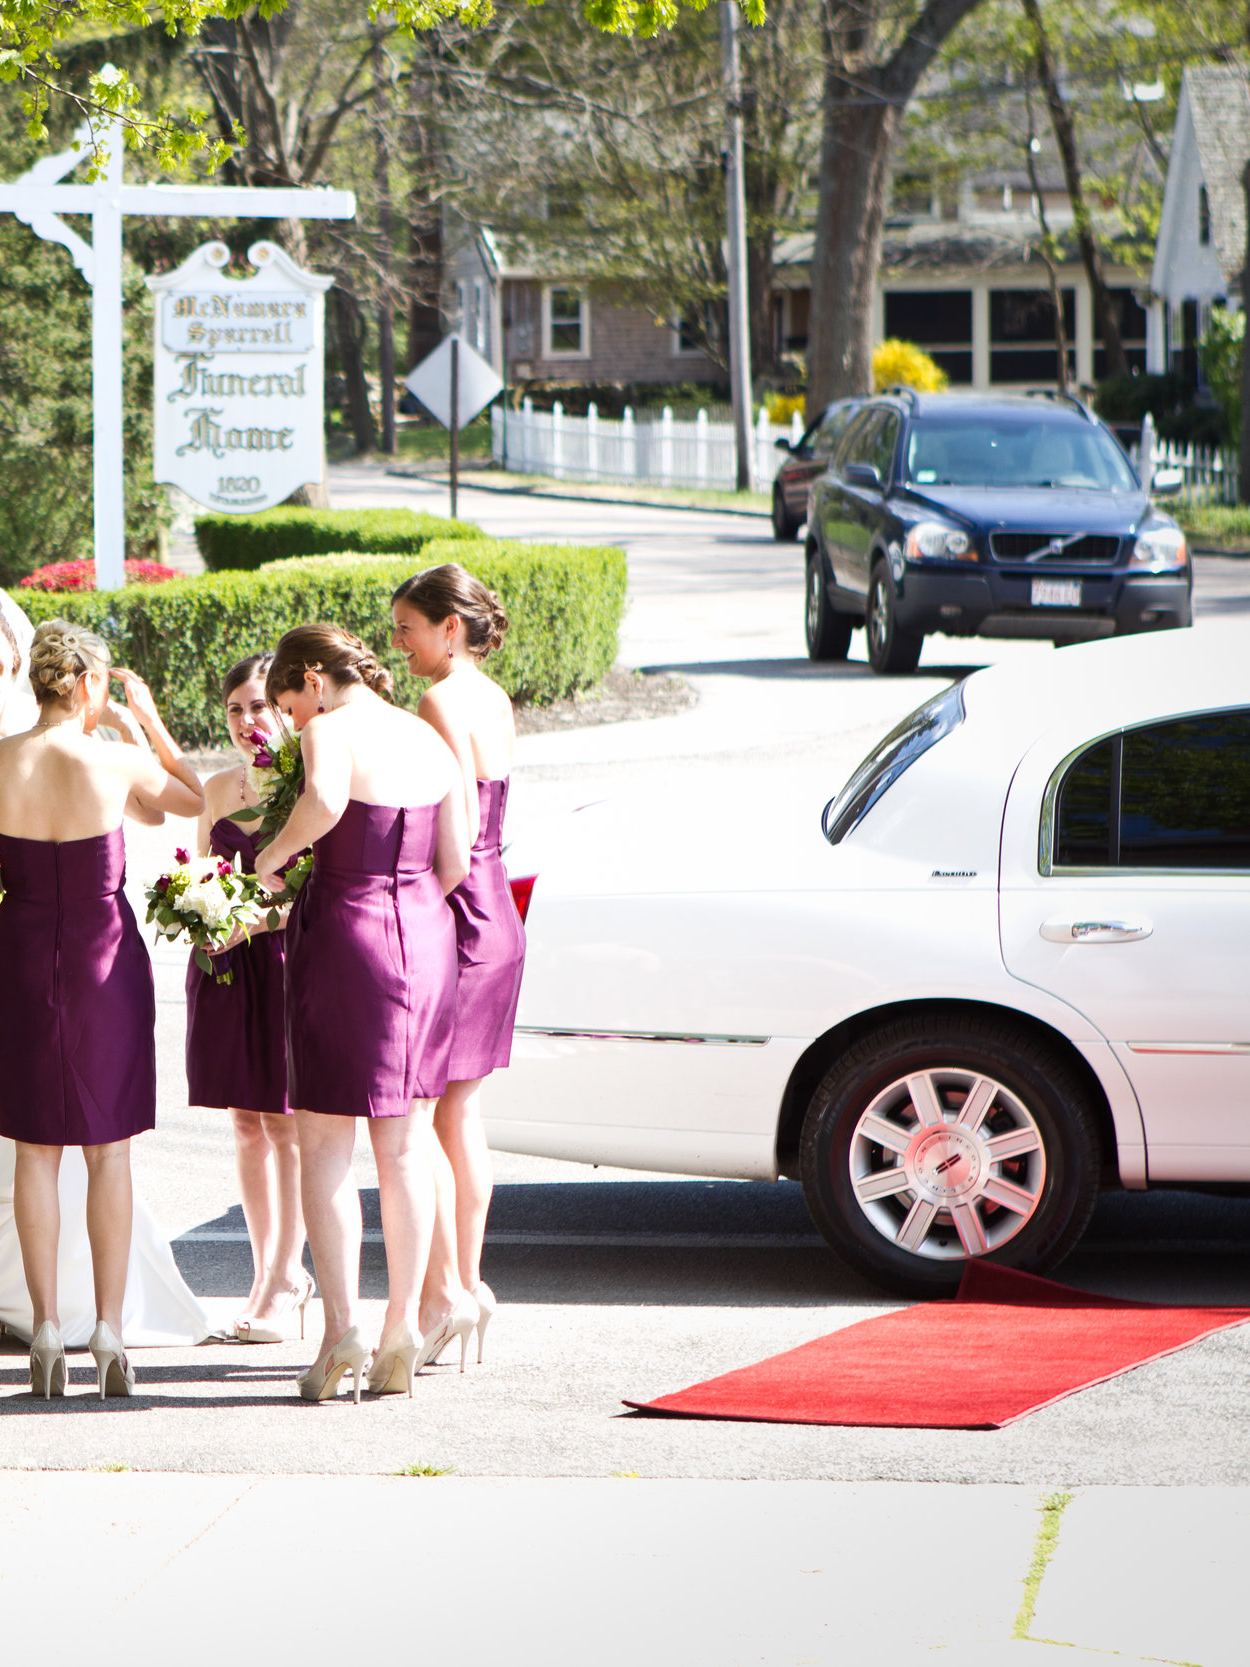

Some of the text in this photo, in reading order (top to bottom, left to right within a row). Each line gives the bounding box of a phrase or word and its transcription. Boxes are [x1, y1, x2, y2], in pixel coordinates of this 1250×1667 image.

[173, 295, 307, 319] McNamara
[187, 322, 293, 348] Sparrell
[167, 352, 307, 403] Funeral
[175, 407, 294, 459] Home
